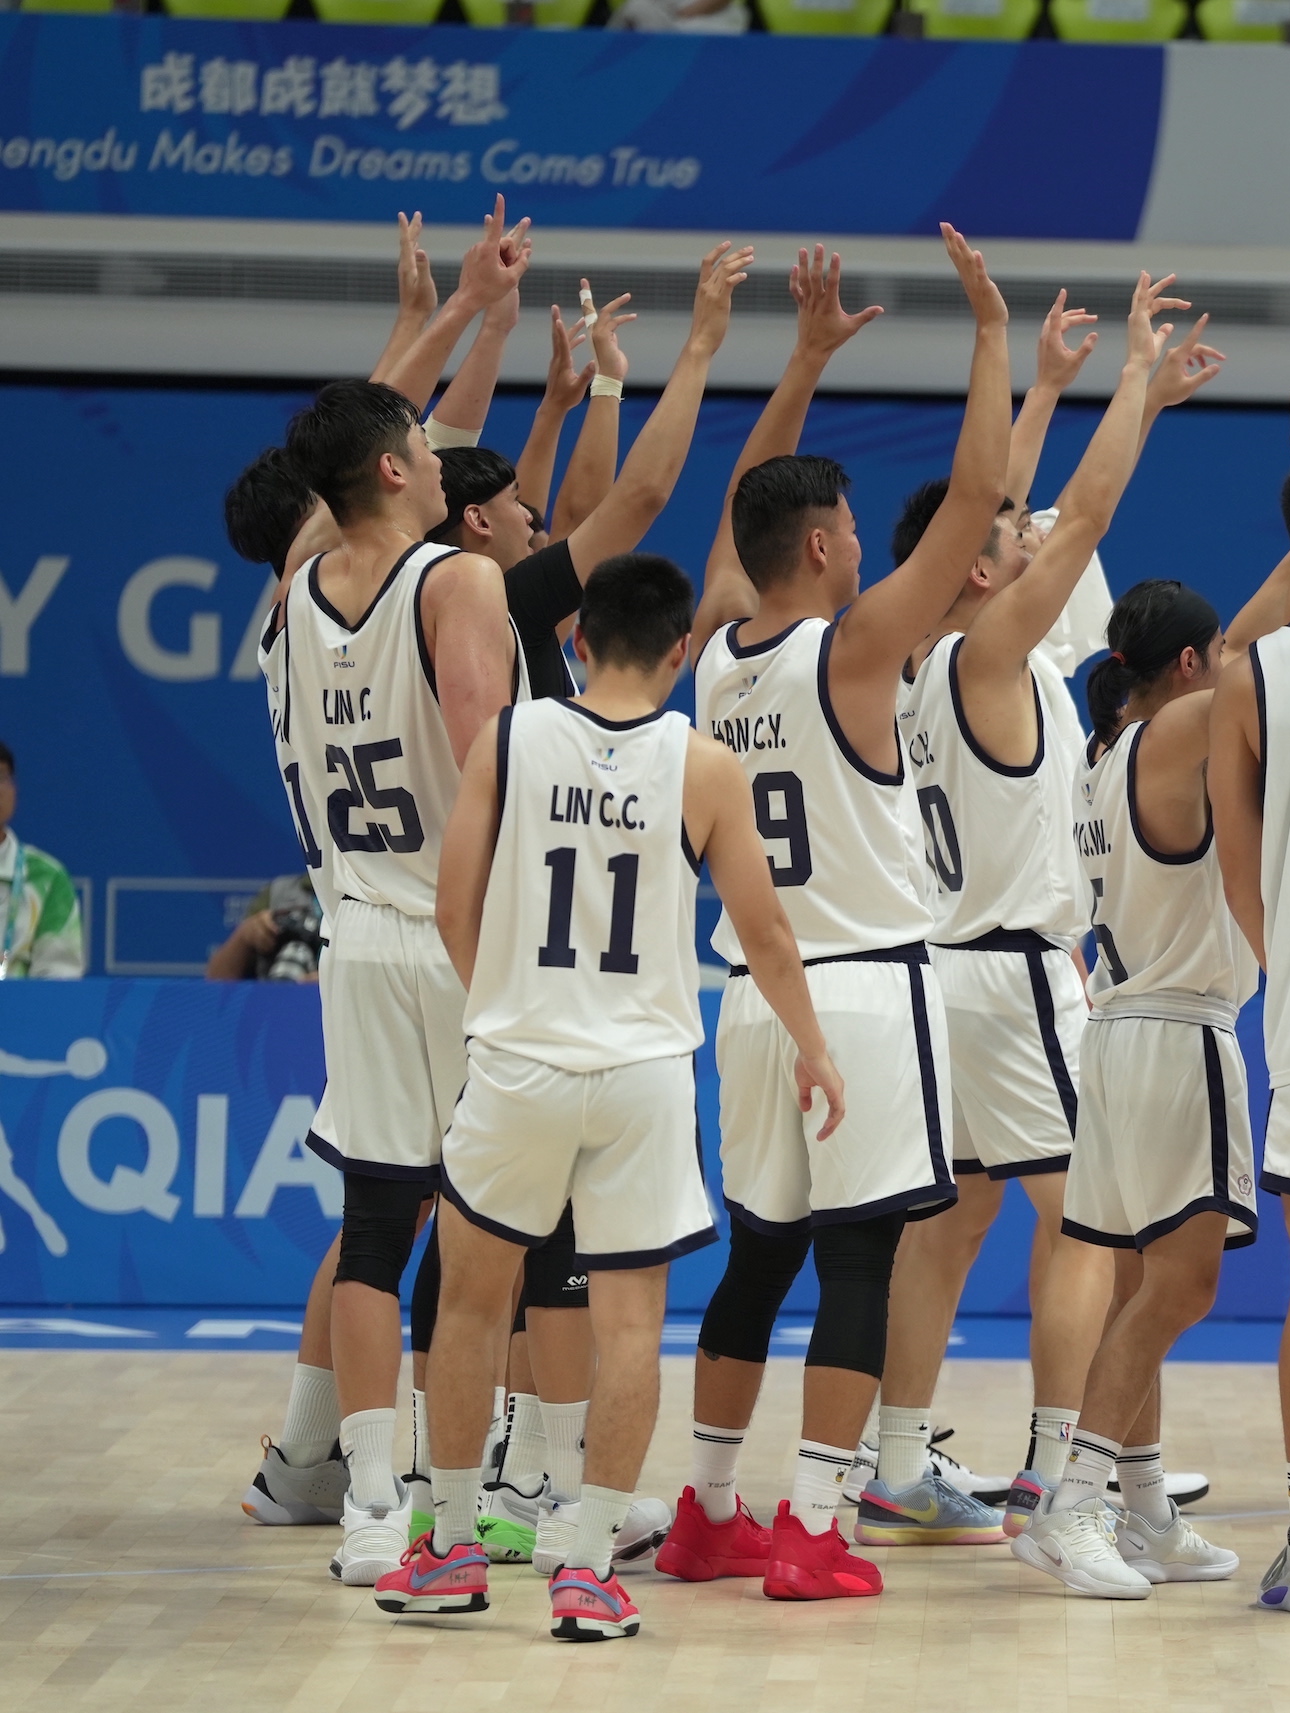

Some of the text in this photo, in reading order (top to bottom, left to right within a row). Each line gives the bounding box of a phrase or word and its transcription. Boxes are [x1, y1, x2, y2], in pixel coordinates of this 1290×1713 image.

[140, 52, 508, 129] 成都成就梦想
[0, 125, 700, 190] engdu Makes Dreams Come True
[333, 661, 356, 669] FISU
[322, 689, 355, 725] LIN
[753, 713, 786, 750] C.Y.
[591, 760, 618, 772] FISU
[325, 737, 425, 853] 25
[550, 785, 645, 831] LIN C.C.
[752, 771, 812, 887] 9
[538, 847, 639, 974] 11
